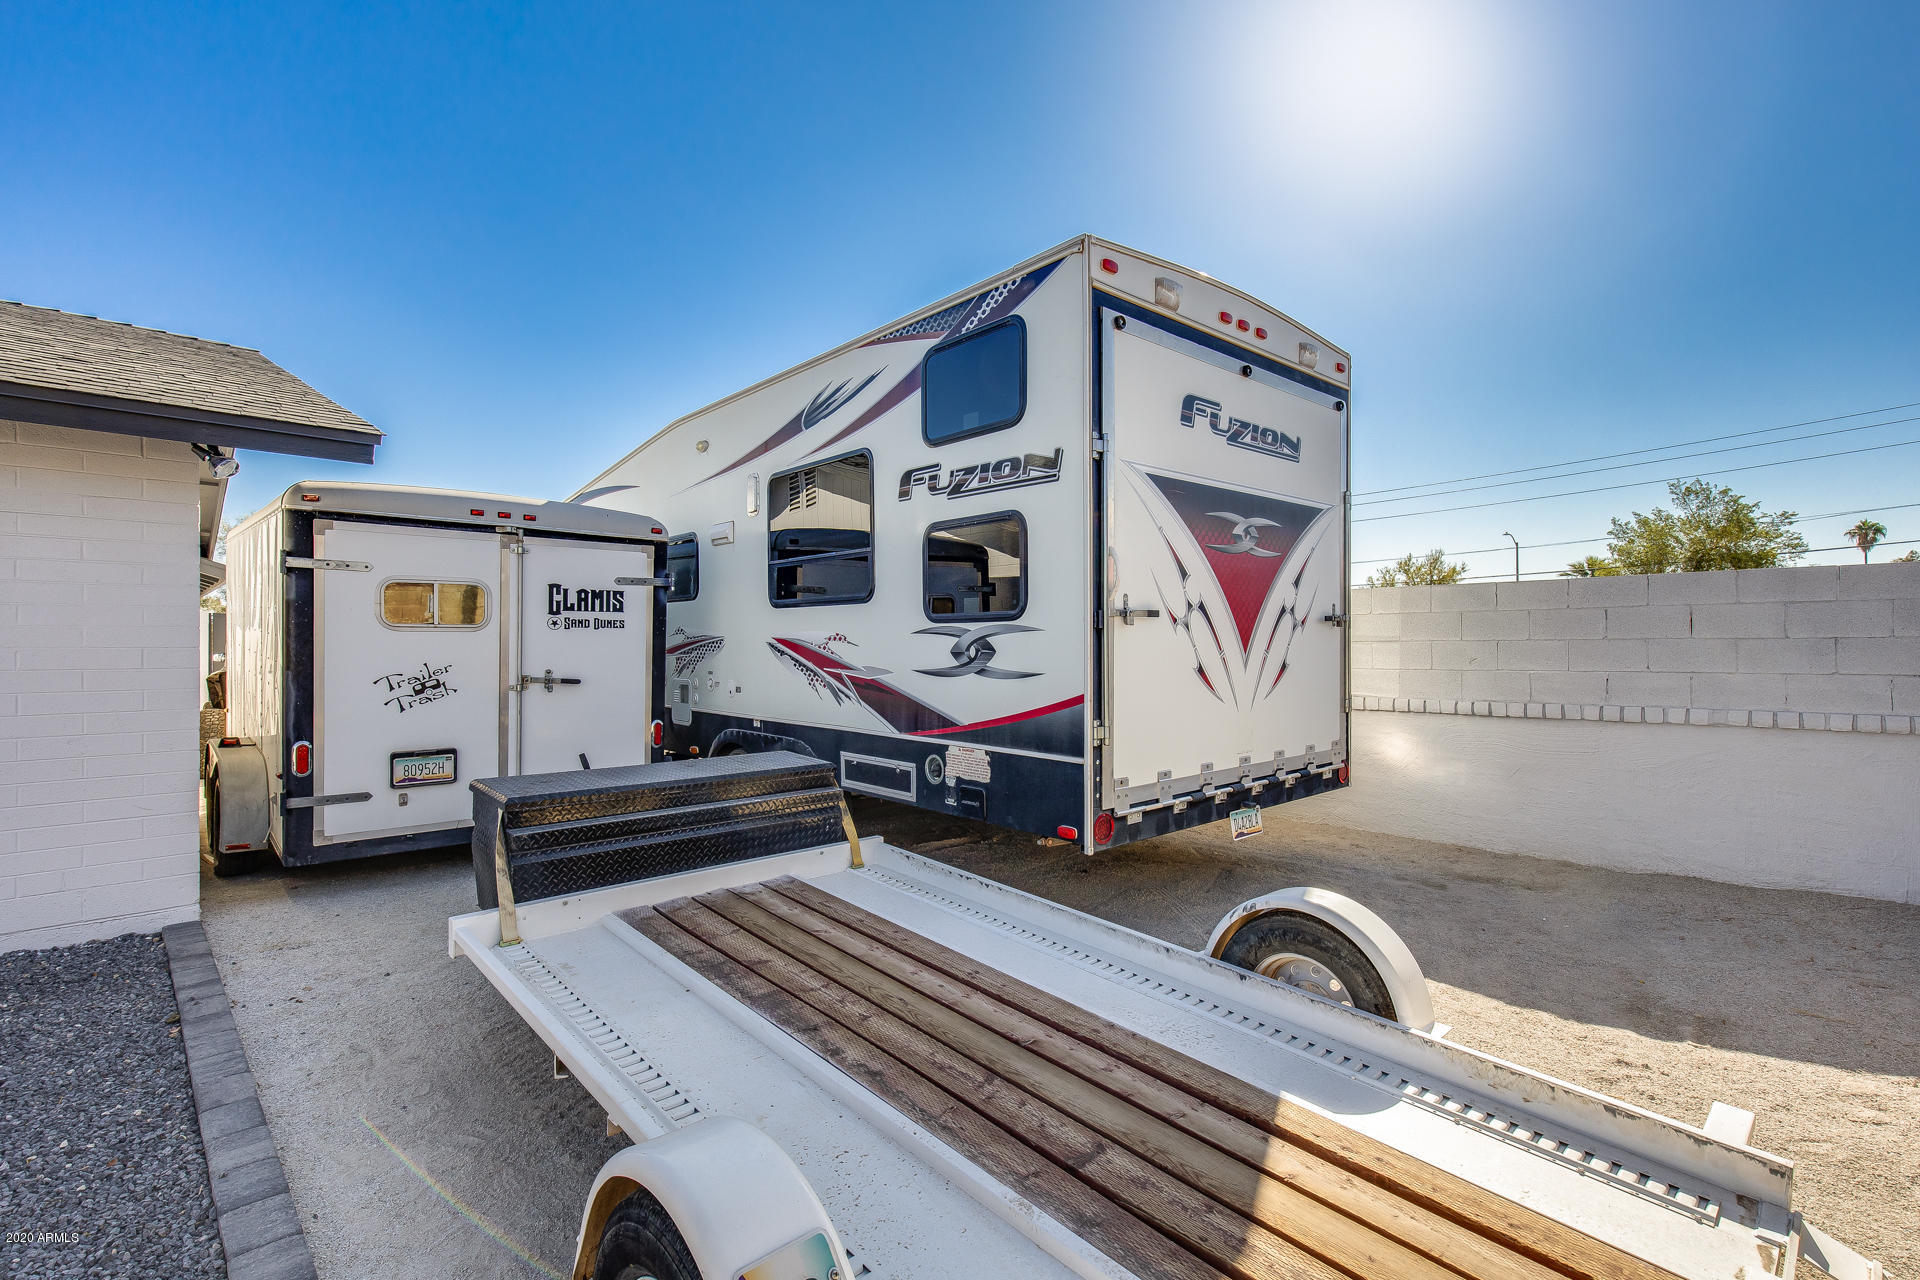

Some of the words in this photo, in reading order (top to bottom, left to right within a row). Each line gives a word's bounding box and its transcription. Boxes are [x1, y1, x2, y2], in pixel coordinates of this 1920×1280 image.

[1180, 394, 1301, 463] FUZION
[898, 447, 1064, 502] FUZION
[372, 662, 453, 692] Trailer
[384, 681, 458, 713] Trash
[403, 762, 445, 777] 80952H
